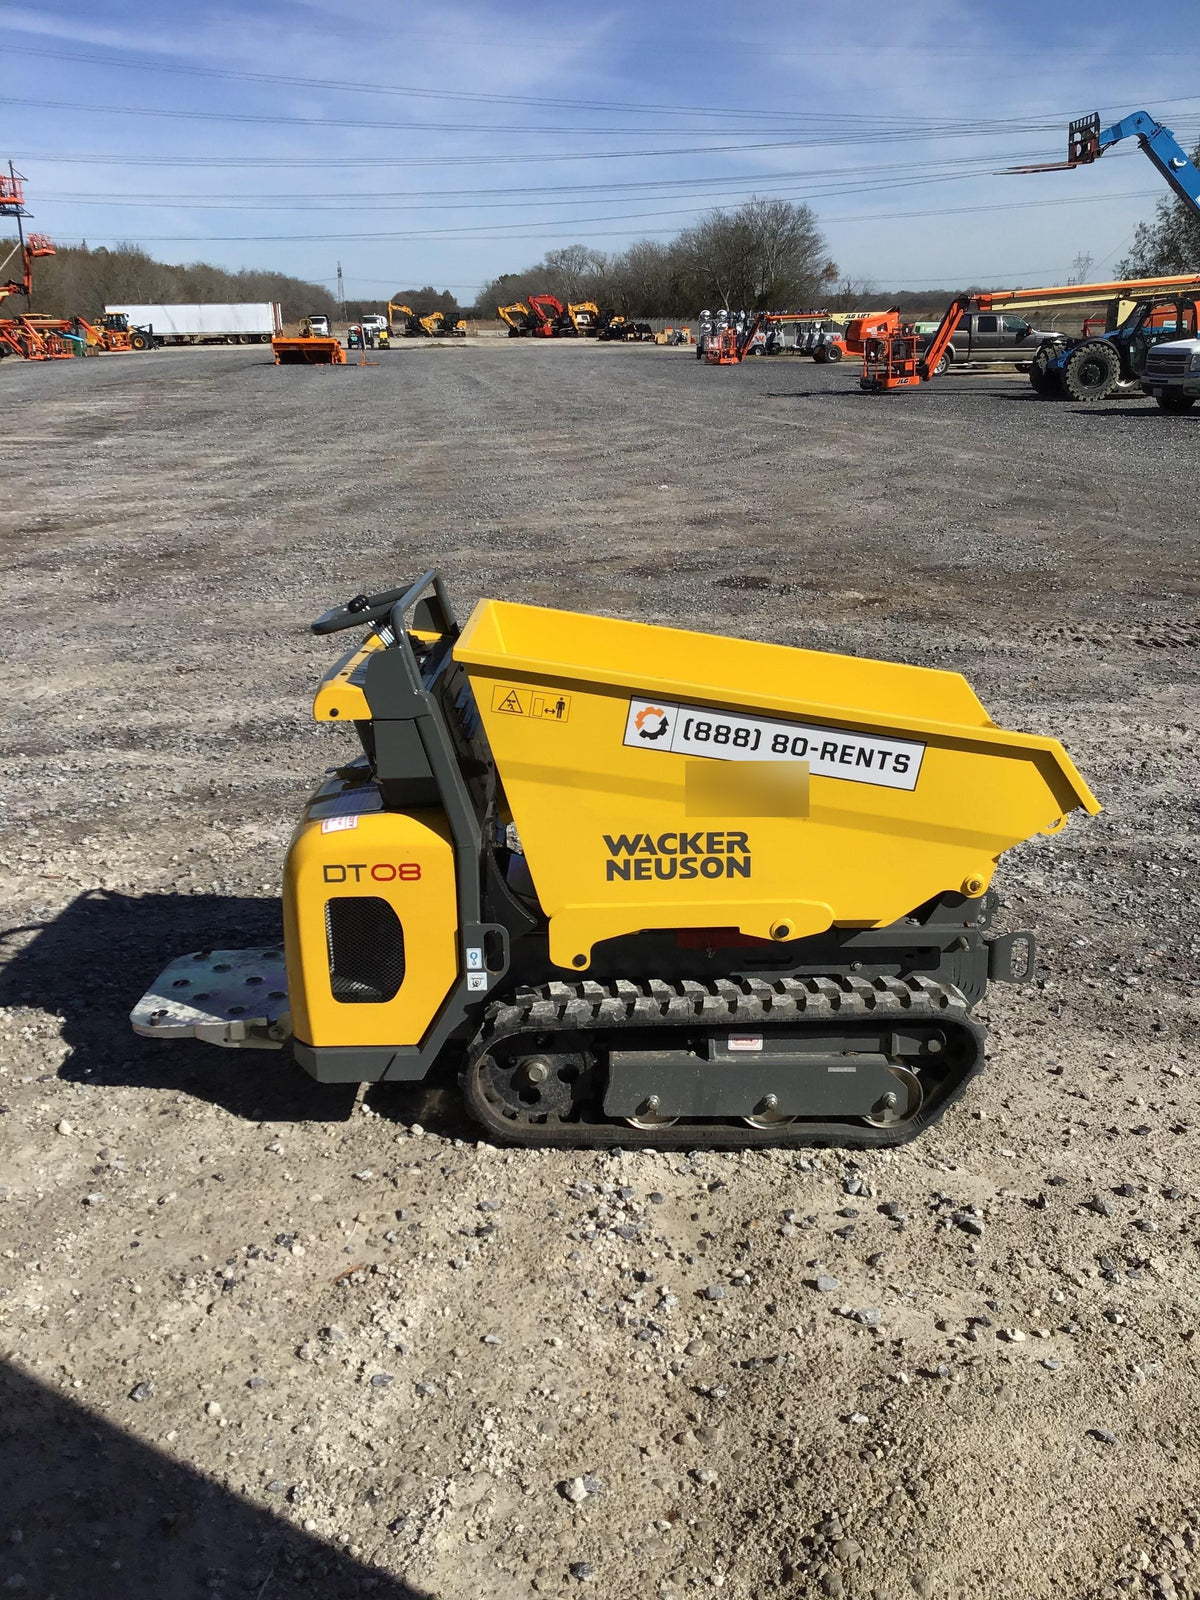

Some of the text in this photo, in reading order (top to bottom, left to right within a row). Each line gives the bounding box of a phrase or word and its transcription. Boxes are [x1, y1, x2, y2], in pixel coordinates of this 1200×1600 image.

[683, 718, 911, 774] (888) 80-RENTS
[602, 831, 751, 857] WACKER
[323, 863, 421, 883] DT08
[606, 856, 751, 881] NEUSON
